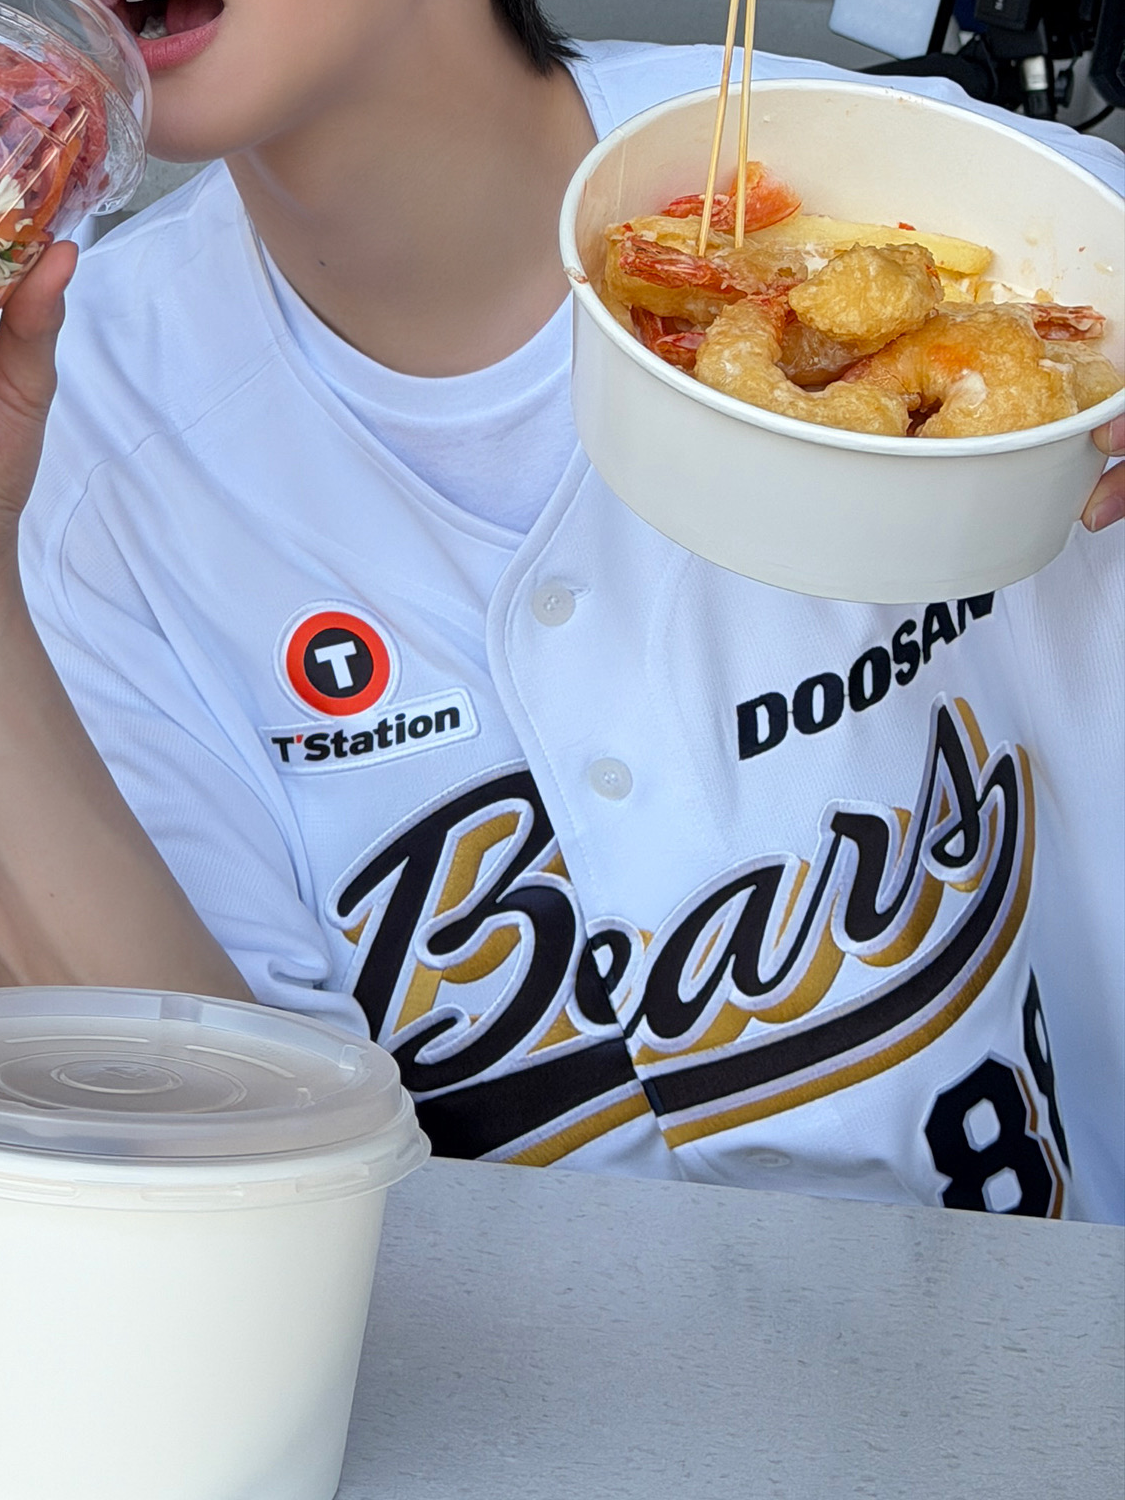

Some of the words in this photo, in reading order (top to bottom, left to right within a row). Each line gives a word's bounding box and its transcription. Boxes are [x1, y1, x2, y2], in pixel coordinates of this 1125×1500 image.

[314, 640, 357, 689] T
[271, 706, 460, 762] T'Station
[328, 693, 1027, 1092] Bears
